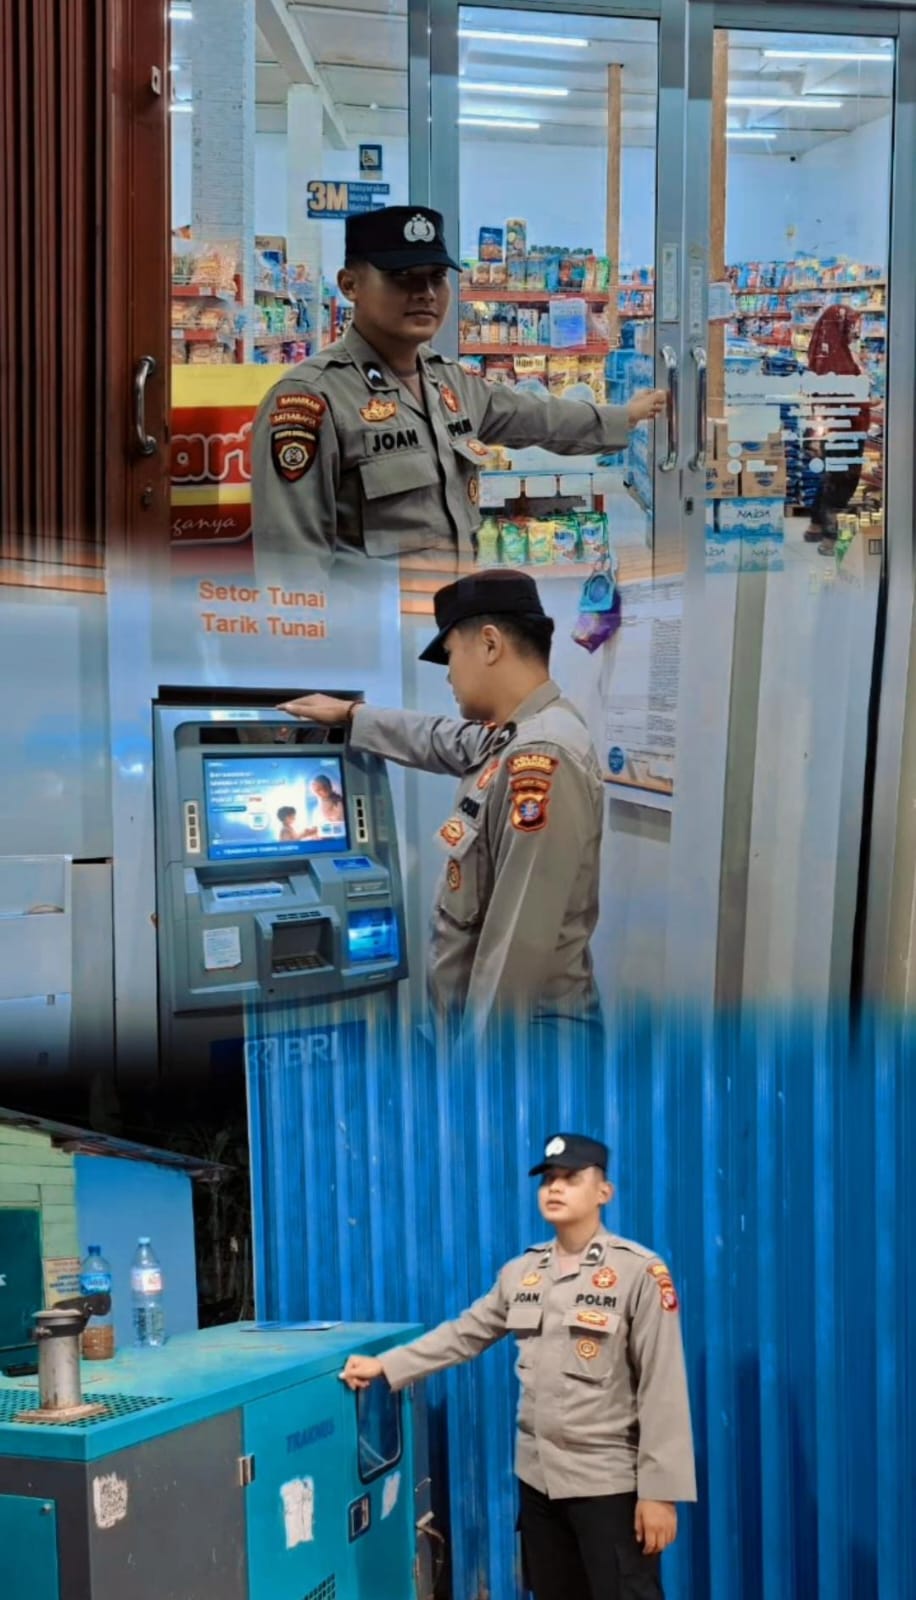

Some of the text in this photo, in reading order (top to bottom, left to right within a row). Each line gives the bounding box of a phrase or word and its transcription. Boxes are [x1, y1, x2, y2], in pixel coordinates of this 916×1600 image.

[308, 182, 348, 211] 3M
[372, 429, 419, 452] JOAN
[199, 581, 326, 609] Setor Tunai
[201, 612, 326, 638] Tarik Tunai
[283, 1031, 339, 1068] BRI
[514, 1293, 541, 1303] JOAN
[575, 1294, 617, 1308] POLRI
